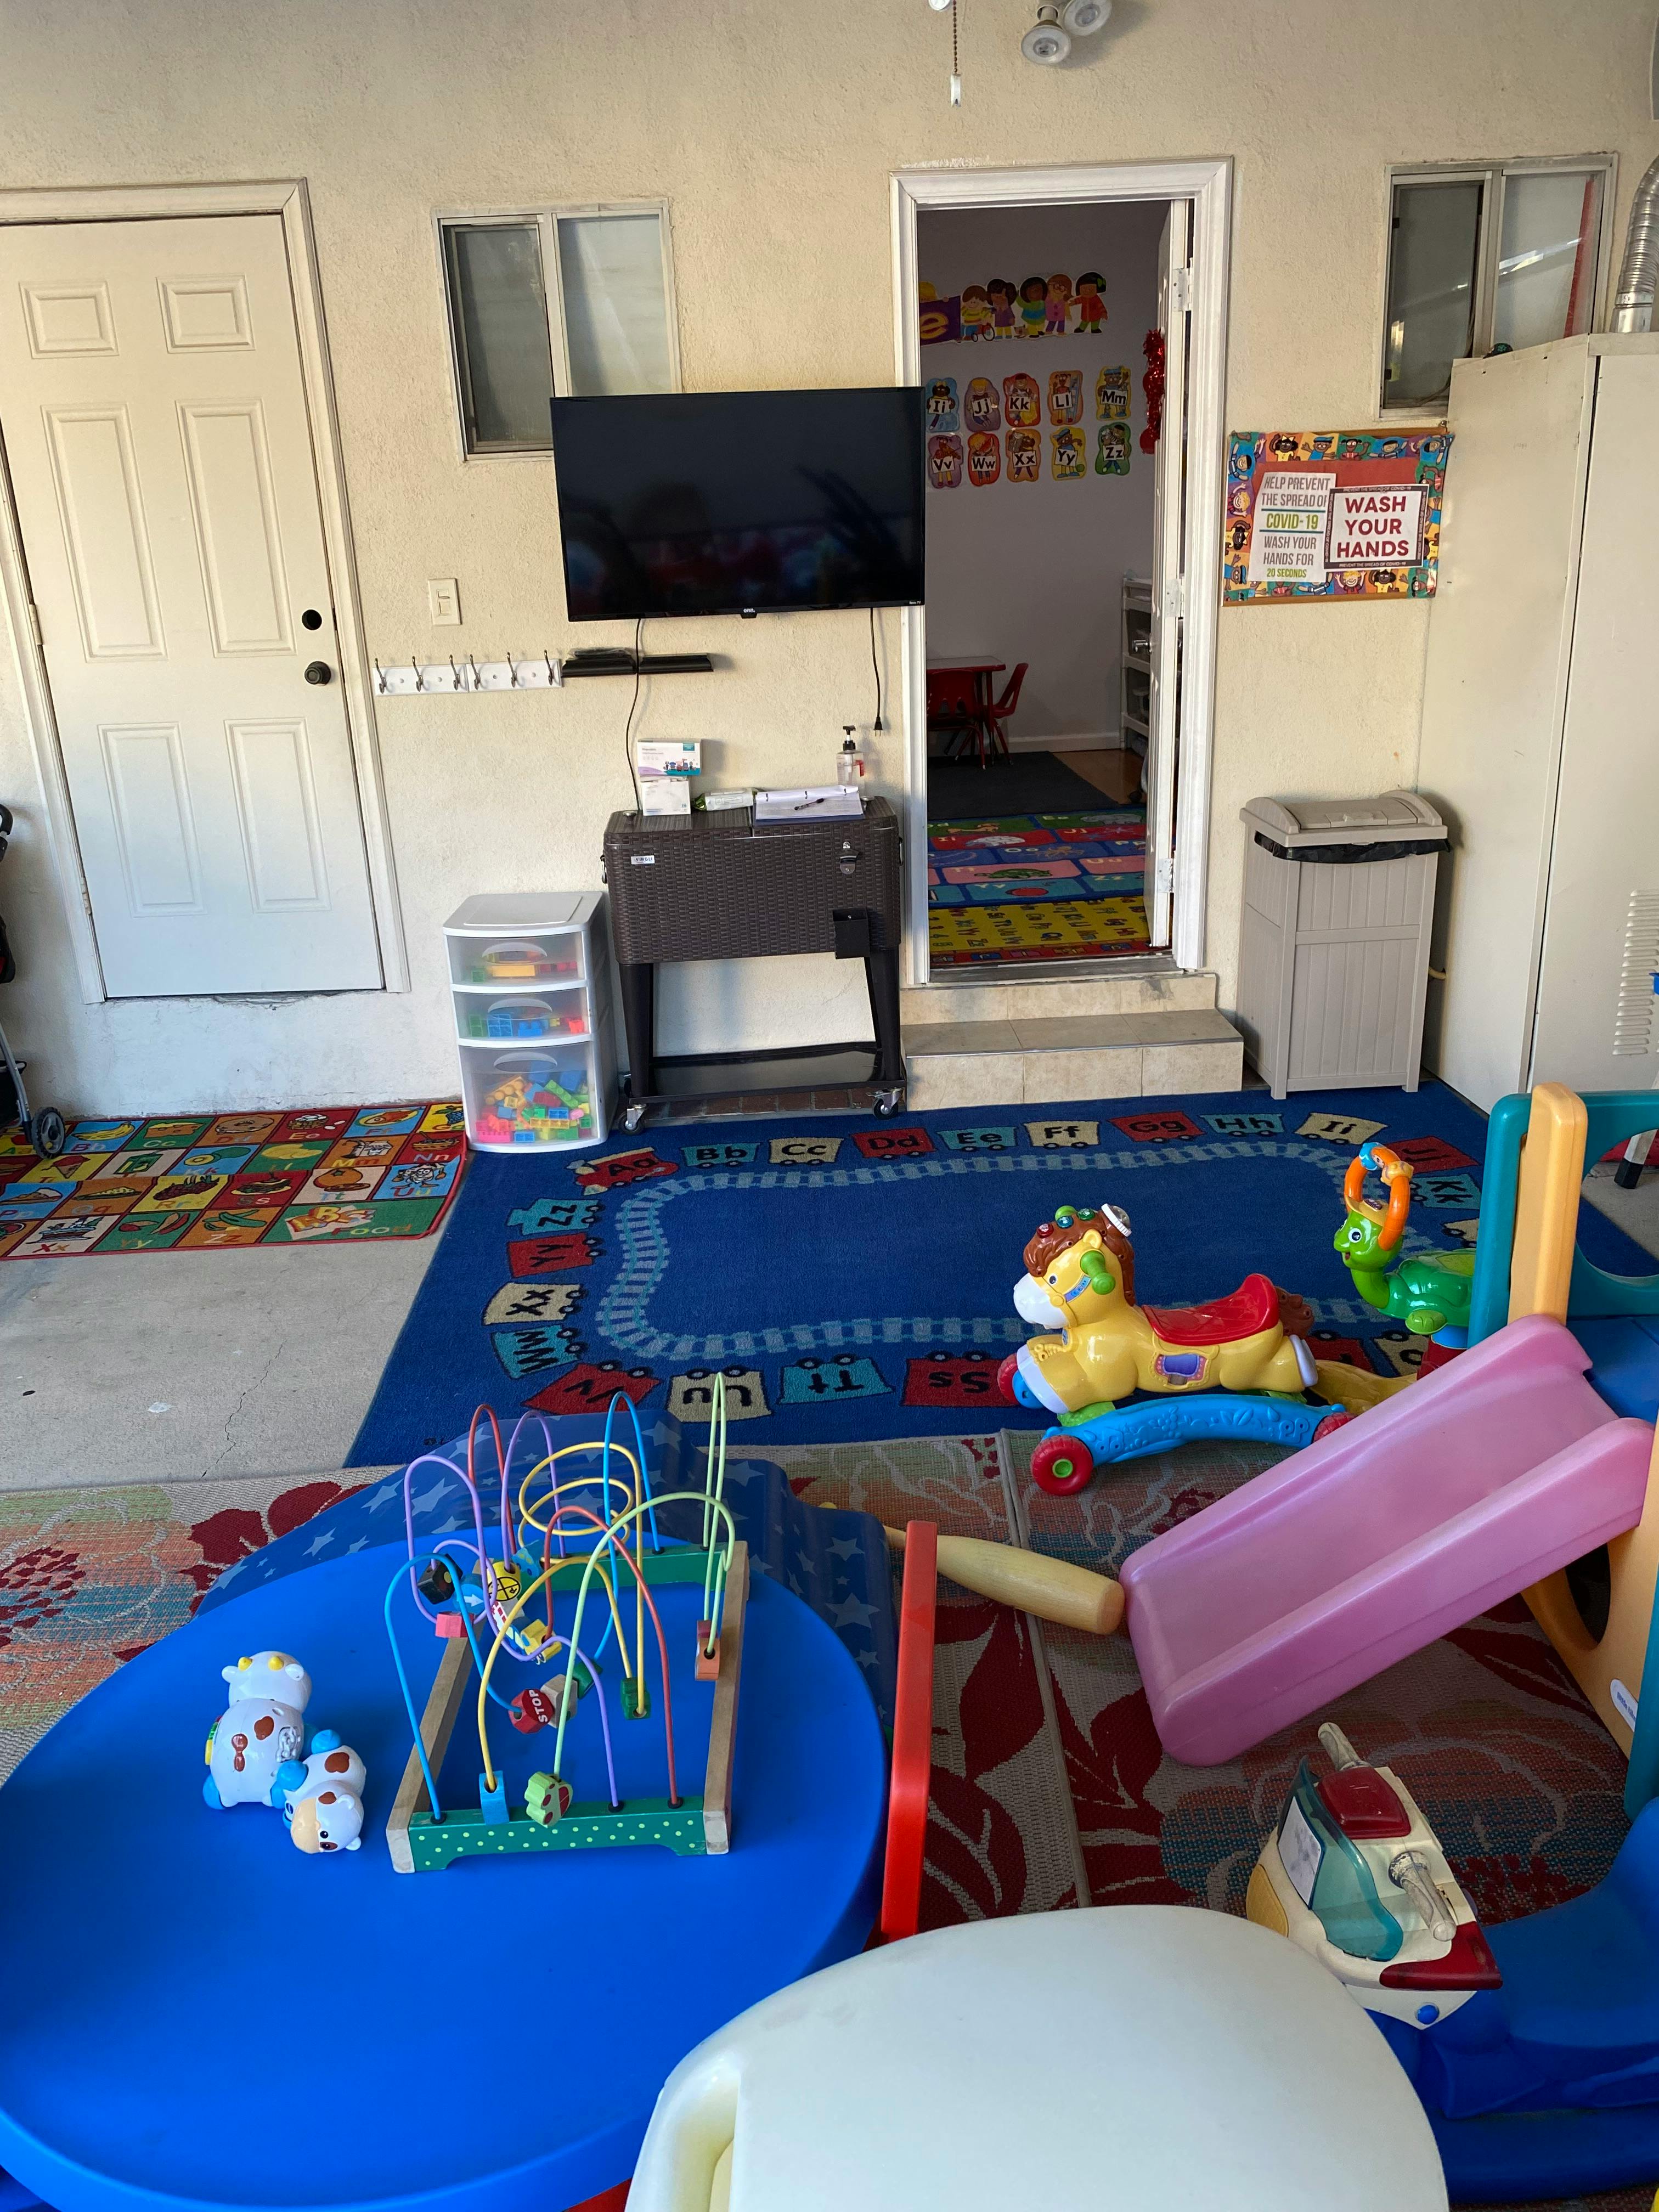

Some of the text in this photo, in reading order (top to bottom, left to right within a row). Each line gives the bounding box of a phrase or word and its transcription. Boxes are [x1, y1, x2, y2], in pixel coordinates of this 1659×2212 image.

[1009, 397, 1030, 410] Kk
[1056, 394, 1070, 408] Ll
[1102, 390, 1126, 405] Mm
[934, 400, 945, 413] Ii
[974, 398, 990, 414] Jj
[1015, 454, 1036, 466] Xx
[1057, 450, 1076, 466] Yy
[1105, 447, 1123, 459] Zz
[933, 459, 952, 471] Vv
[972, 457, 995, 470] Ww
[1264, 476, 1330, 490] HELP PREVENT
[1262, 493, 1278, 506] THE
[1280, 494, 1316, 507] SPREAD
[1345, 496, 1406, 514] WASH
[1345, 518, 1402, 535] YOUR
[1264, 535, 1317, 549] WASH YOUR
[1337, 540, 1409, 558] HANDS
[1263, 552, 1314, 566] HANDS FOR
[1267, 568, 1307, 578] 20 SECONDS
[1128, 1120, 1188, 1133] Gg
[1215, 1117, 1276, 1129] Hh
[956, 1132, 1003, 1145] Ee
[1044, 1126, 1080, 1139] Ff
[70, 1143, 106, 1152] Bb
[781, 1143, 827, 1156] Cc
[867, 1135, 921, 1150] Dd
[414, 1153, 449, 1162] Nn
[696, 1145, 747, 1161] Bb
[331, 1159, 380, 1168] Mm
[608, 1158, 657, 1177] Aa
[1426, 1181, 1474, 1204] Kk
[538, 1205, 577, 1227] Zz
[204, 1234, 242, 1244] Zz
[32, 1243, 70, 1253] Xx
[529, 1244, 574, 1267] Yy
[505, 1289, 555, 1316] Xx
[513, 1330, 560, 1373] Ww
[809, 1369, 865, 1394] Tt
[928, 1371, 991, 1394] Ss
[528, 1689, 548, 1723] STOP
